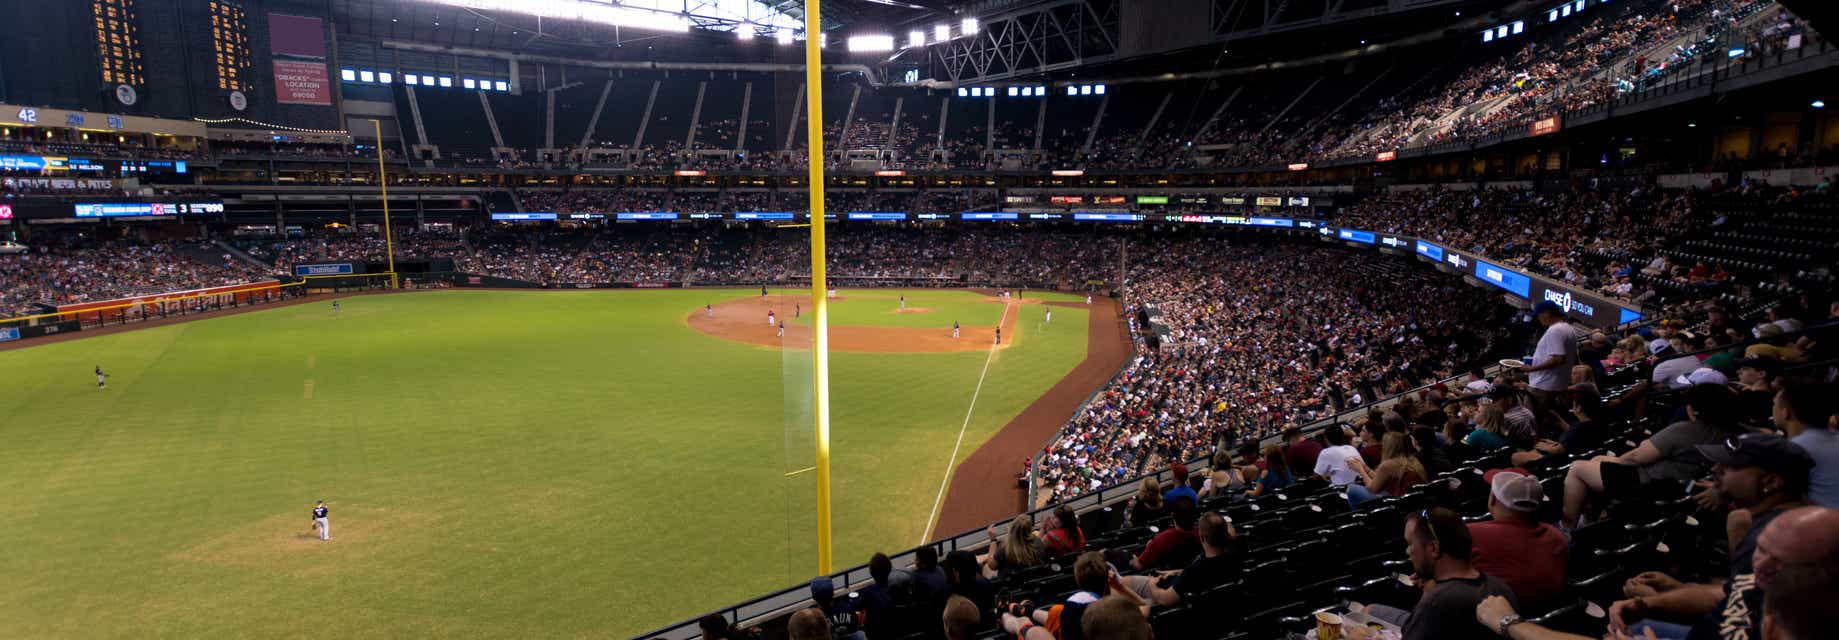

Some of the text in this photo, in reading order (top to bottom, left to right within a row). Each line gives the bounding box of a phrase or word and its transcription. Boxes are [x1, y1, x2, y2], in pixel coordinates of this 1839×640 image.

[18, 109, 36, 122] 42
[180, 204, 188, 213] 3
[206, 203, 224, 213] 890
[1544, 288, 1564, 307] CHASE
